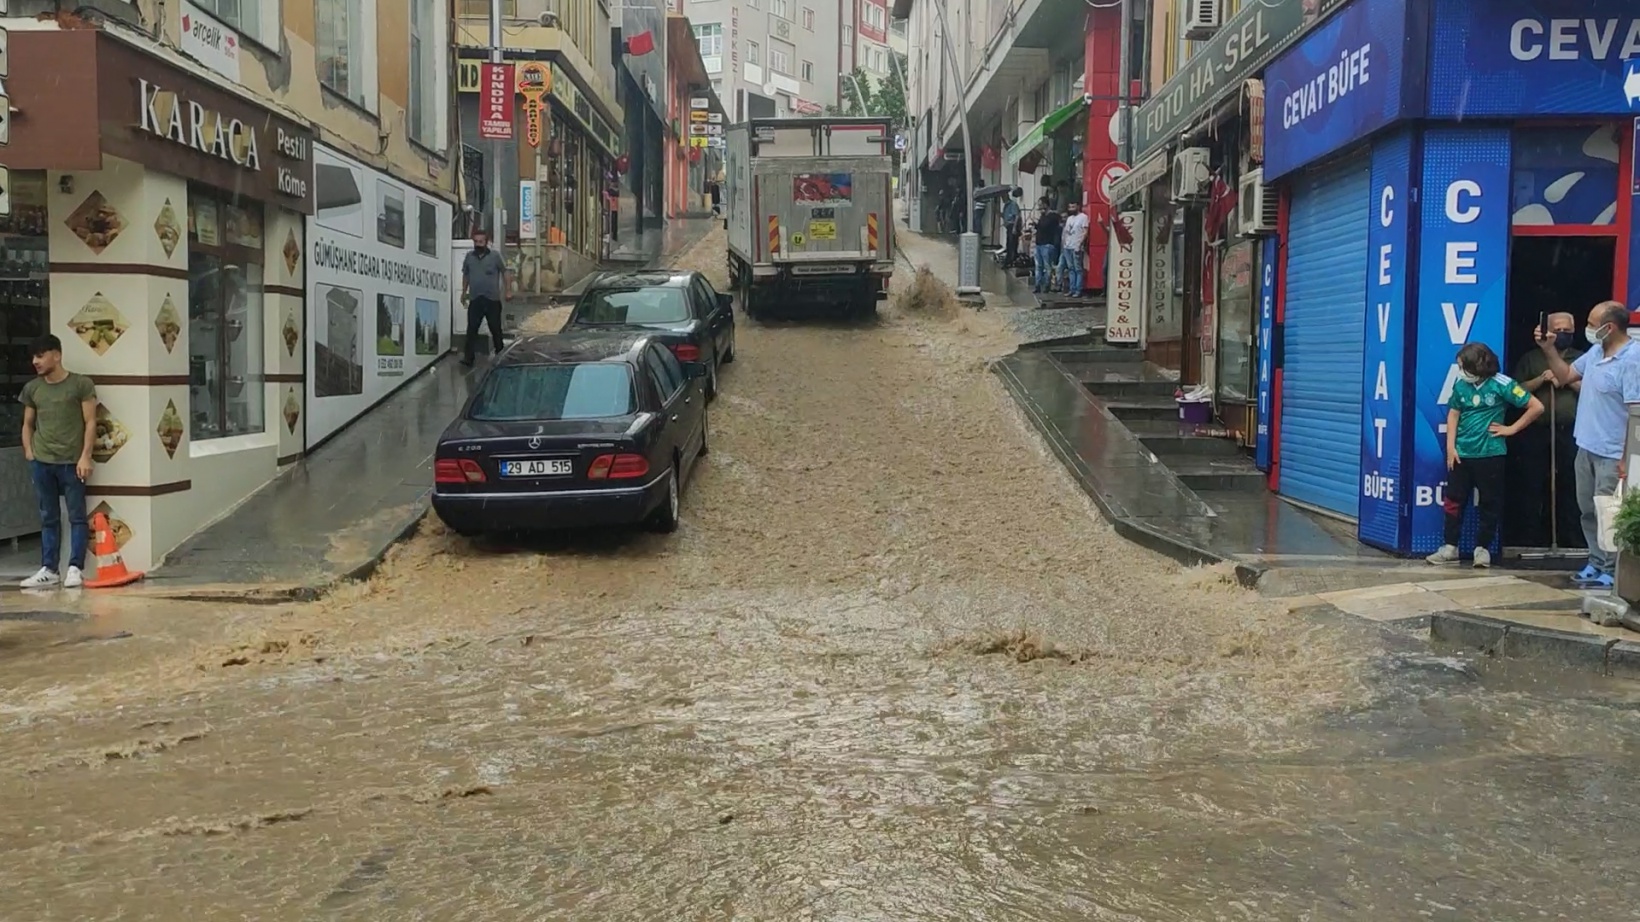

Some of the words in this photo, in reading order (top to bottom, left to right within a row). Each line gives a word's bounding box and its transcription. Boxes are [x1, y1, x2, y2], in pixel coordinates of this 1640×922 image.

[192, 20, 222, 50] arçelik
[490, 65, 505, 119] KUNDURA
[1145, 83, 1184, 141] FOTO
[1189, 9, 1270, 103] HA-SEL
[1283, 72, 1326, 129] CEVAT
[1328, 42, 1371, 104] BÜFE
[138, 77, 261, 171] KARACA
[277, 127, 306, 161] Pestil
[278, 167, 307, 199] Köme
[522, 187, 532, 221] Letoon
[314, 236, 357, 275] GÜMÜŞHANE
[358, 252, 381, 279] IZGARA
[394, 260, 415, 287] FABRİKA
[1116, 258, 1134, 313] GÜMÜŞ
[1108, 326, 1138, 338] SAAT
[1116, 314, 1130, 324] &
[1261, 263, 1272, 414] CEVAT
[1374, 185, 1395, 459] CEVAT
[508, 462, 522, 474] 29
[528, 461, 545, 474] AD
[551, 460, 571, 473] 515
[1364, 470, 1395, 502] BÜFE
